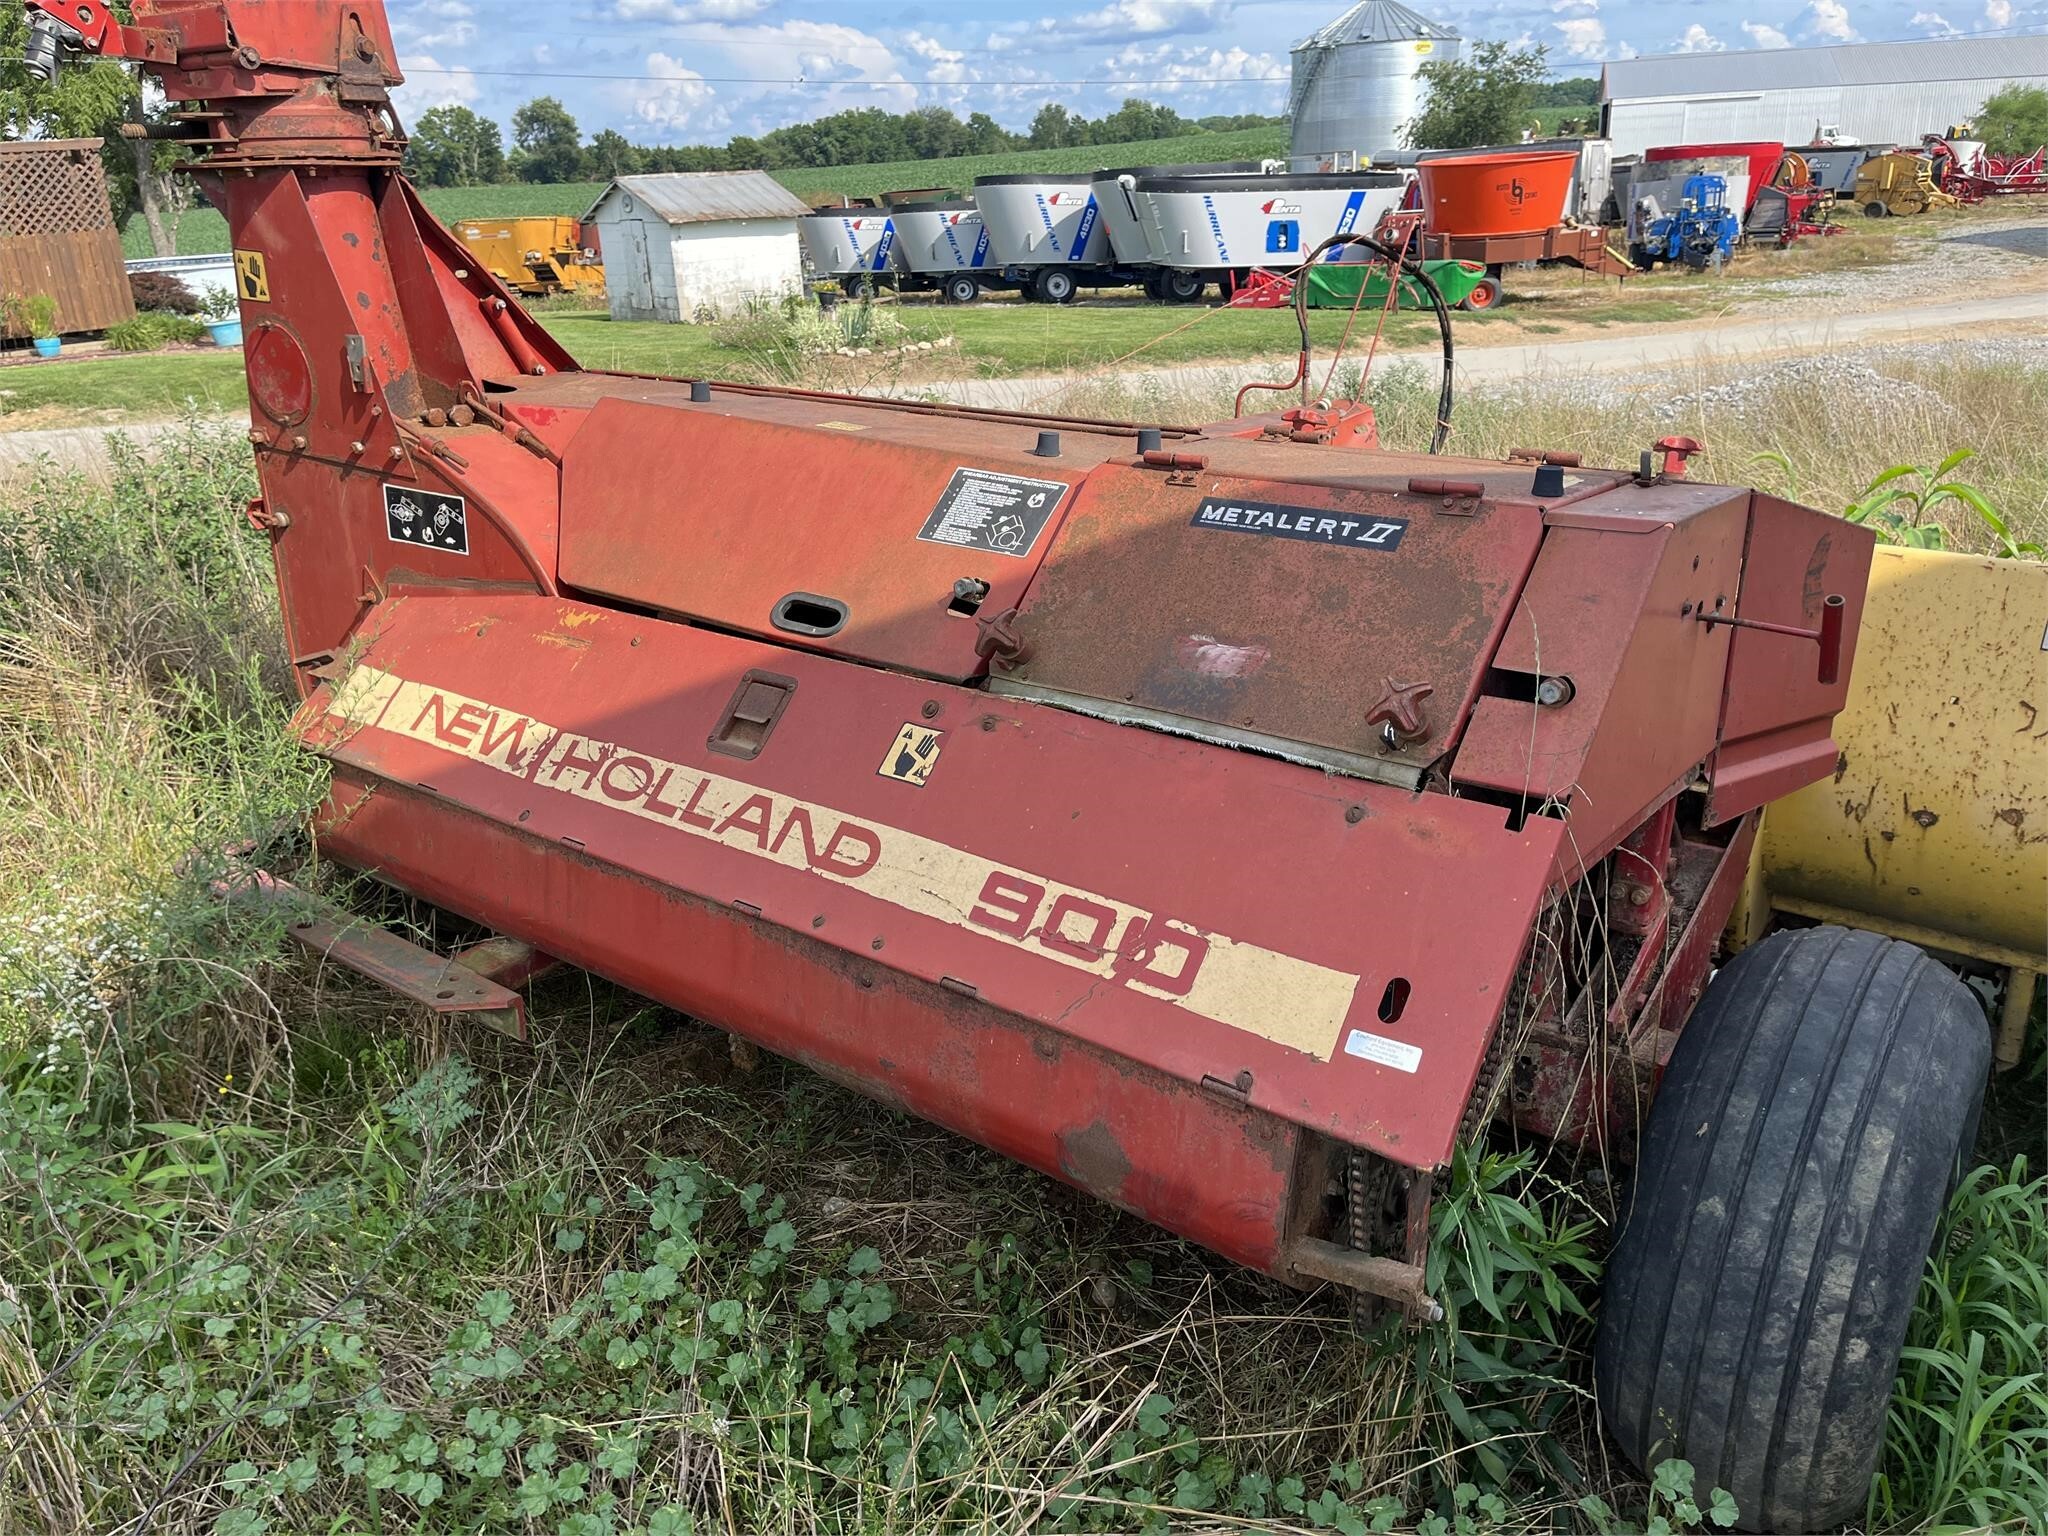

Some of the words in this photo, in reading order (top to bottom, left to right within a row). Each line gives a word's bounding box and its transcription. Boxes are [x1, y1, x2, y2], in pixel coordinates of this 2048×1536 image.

[1035, 193, 1061, 252] HURRICANE
[1203, 195, 1230, 263] HURRICANE
[1269, 197, 1301, 214] PENTA
[842, 218, 866, 268] HURRICANE
[939, 213, 965, 266] HURRICANE
[1201, 504, 1359, 537] METALERT
[410, 693, 531, 773] NEW
[549, 735, 883, 879] HOLLAND
[968, 870, 1210, 996] 900
